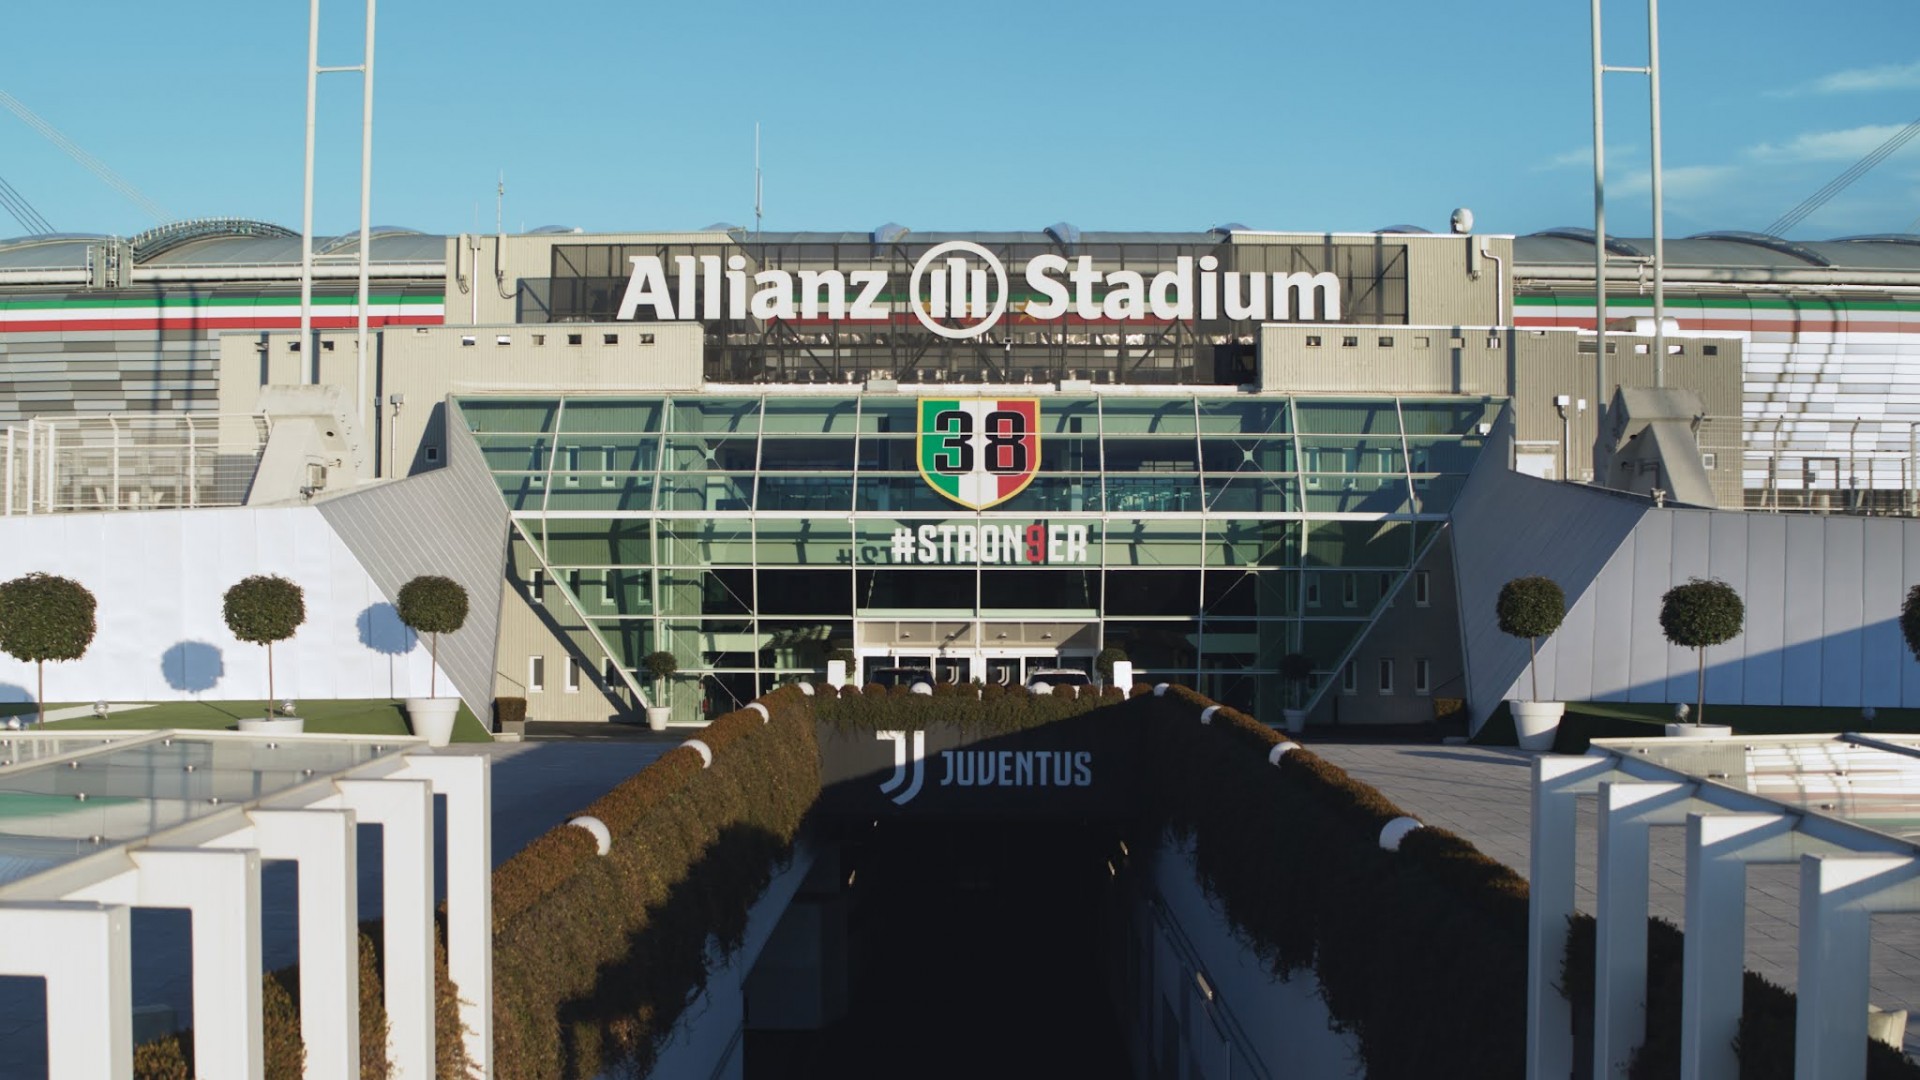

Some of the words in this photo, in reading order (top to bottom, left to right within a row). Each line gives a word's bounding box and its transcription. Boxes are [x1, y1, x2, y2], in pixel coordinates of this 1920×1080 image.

[617, 255, 889, 320] Allianz
[1025, 254, 1342, 321] Stadium
[934, 410, 1028, 476] 38
[891, 524, 1087, 562] #STRON9ER
[940, 751, 1091, 786] JUVENTUS
